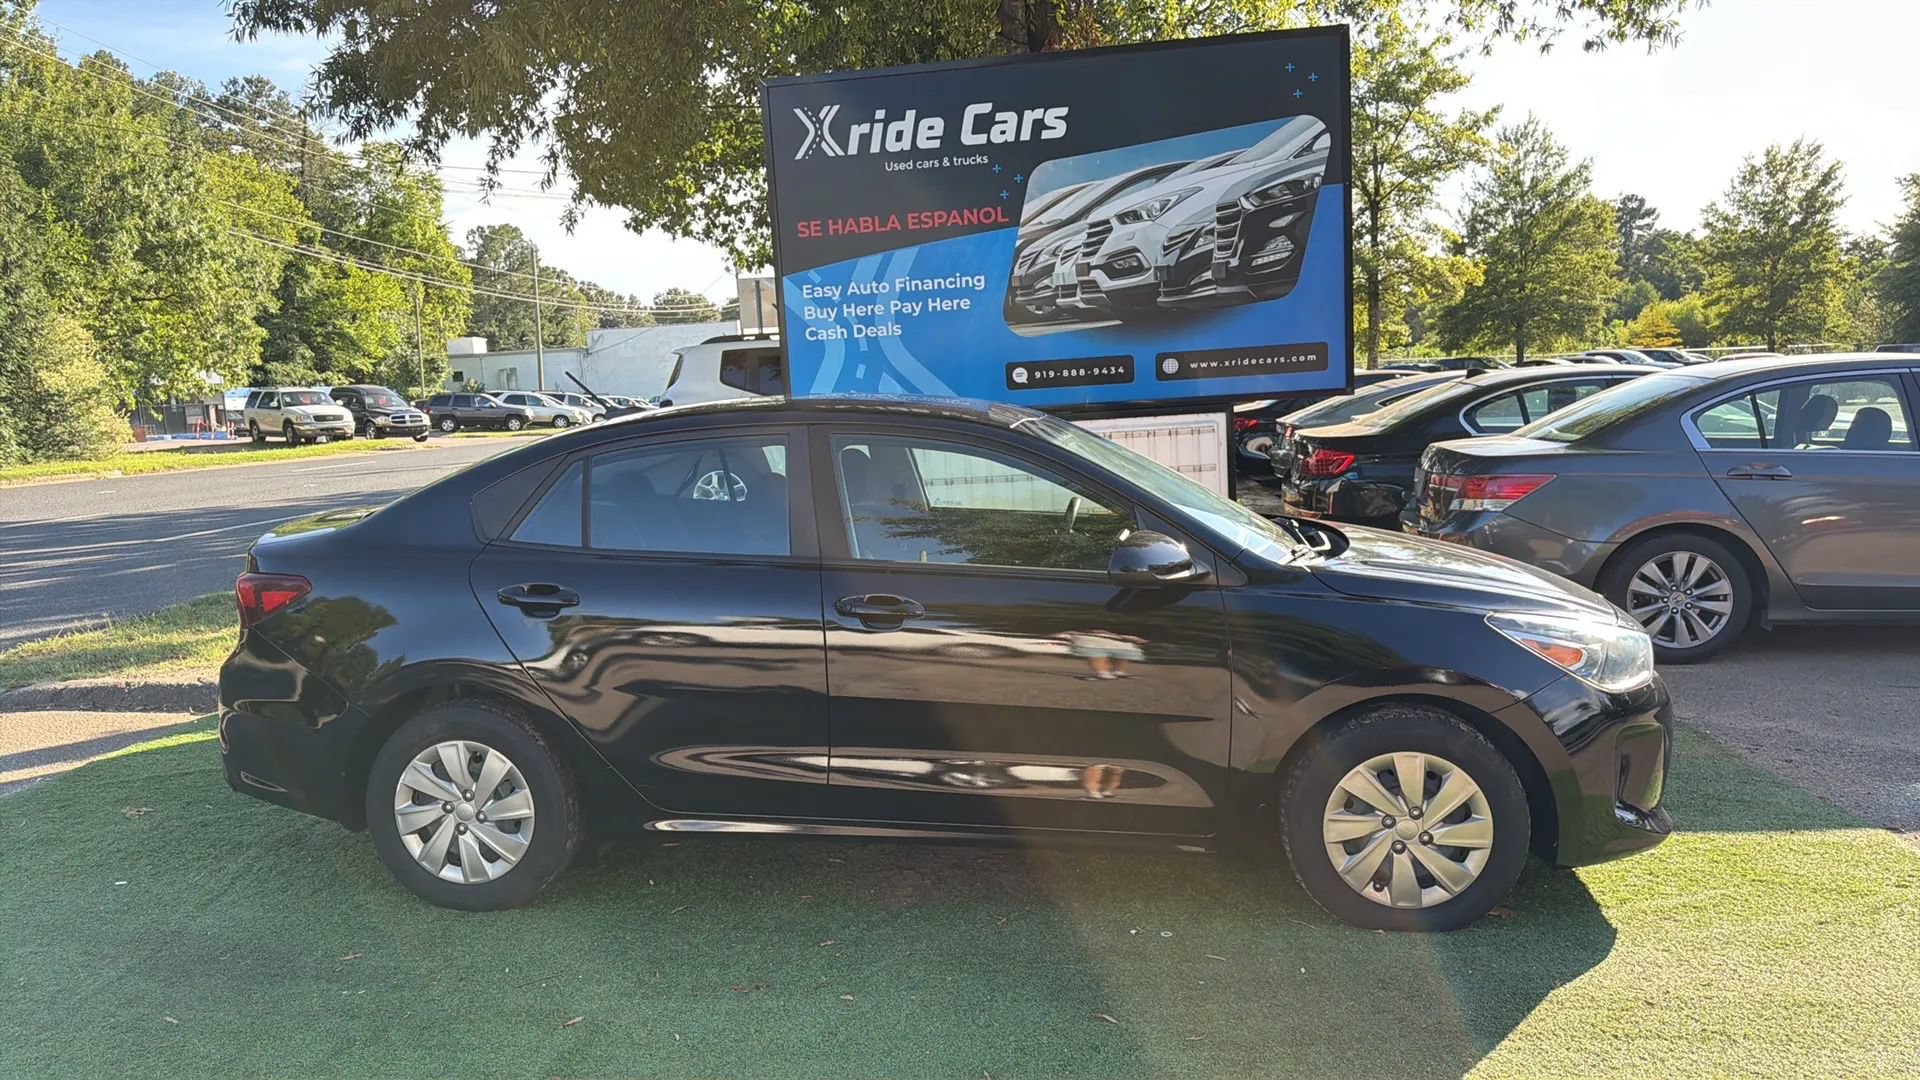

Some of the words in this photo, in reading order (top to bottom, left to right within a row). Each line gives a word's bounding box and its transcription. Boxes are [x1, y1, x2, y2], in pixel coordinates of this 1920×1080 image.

[793, 104, 945, 160] Xride
[960, 102, 1069, 146] Cars
[885, 157, 913, 172] Used
[916, 158, 940, 170] cars
[942, 156, 951, 167] &
[953, 153, 989, 166] trucks
[797, 220, 823, 238] SE
[828, 214, 901, 236] HABLA
[907, 206, 1009, 230] ESPANOL
[802, 284, 842, 300] Easy
[847, 280, 890, 297] Auto
[895, 272, 985, 292] Financing
[804, 305, 838, 322] Buy
[843, 302, 885, 318] Here
[890, 300, 923, 316] Pay
[928, 297, 971, 312] Here
[805, 324, 848, 341] Cash
[853, 322, 902, 338] Deals
[1189, 353, 1317, 369] www.xridecars.com
[1034, 365, 1125, 380] 919-888-9434
